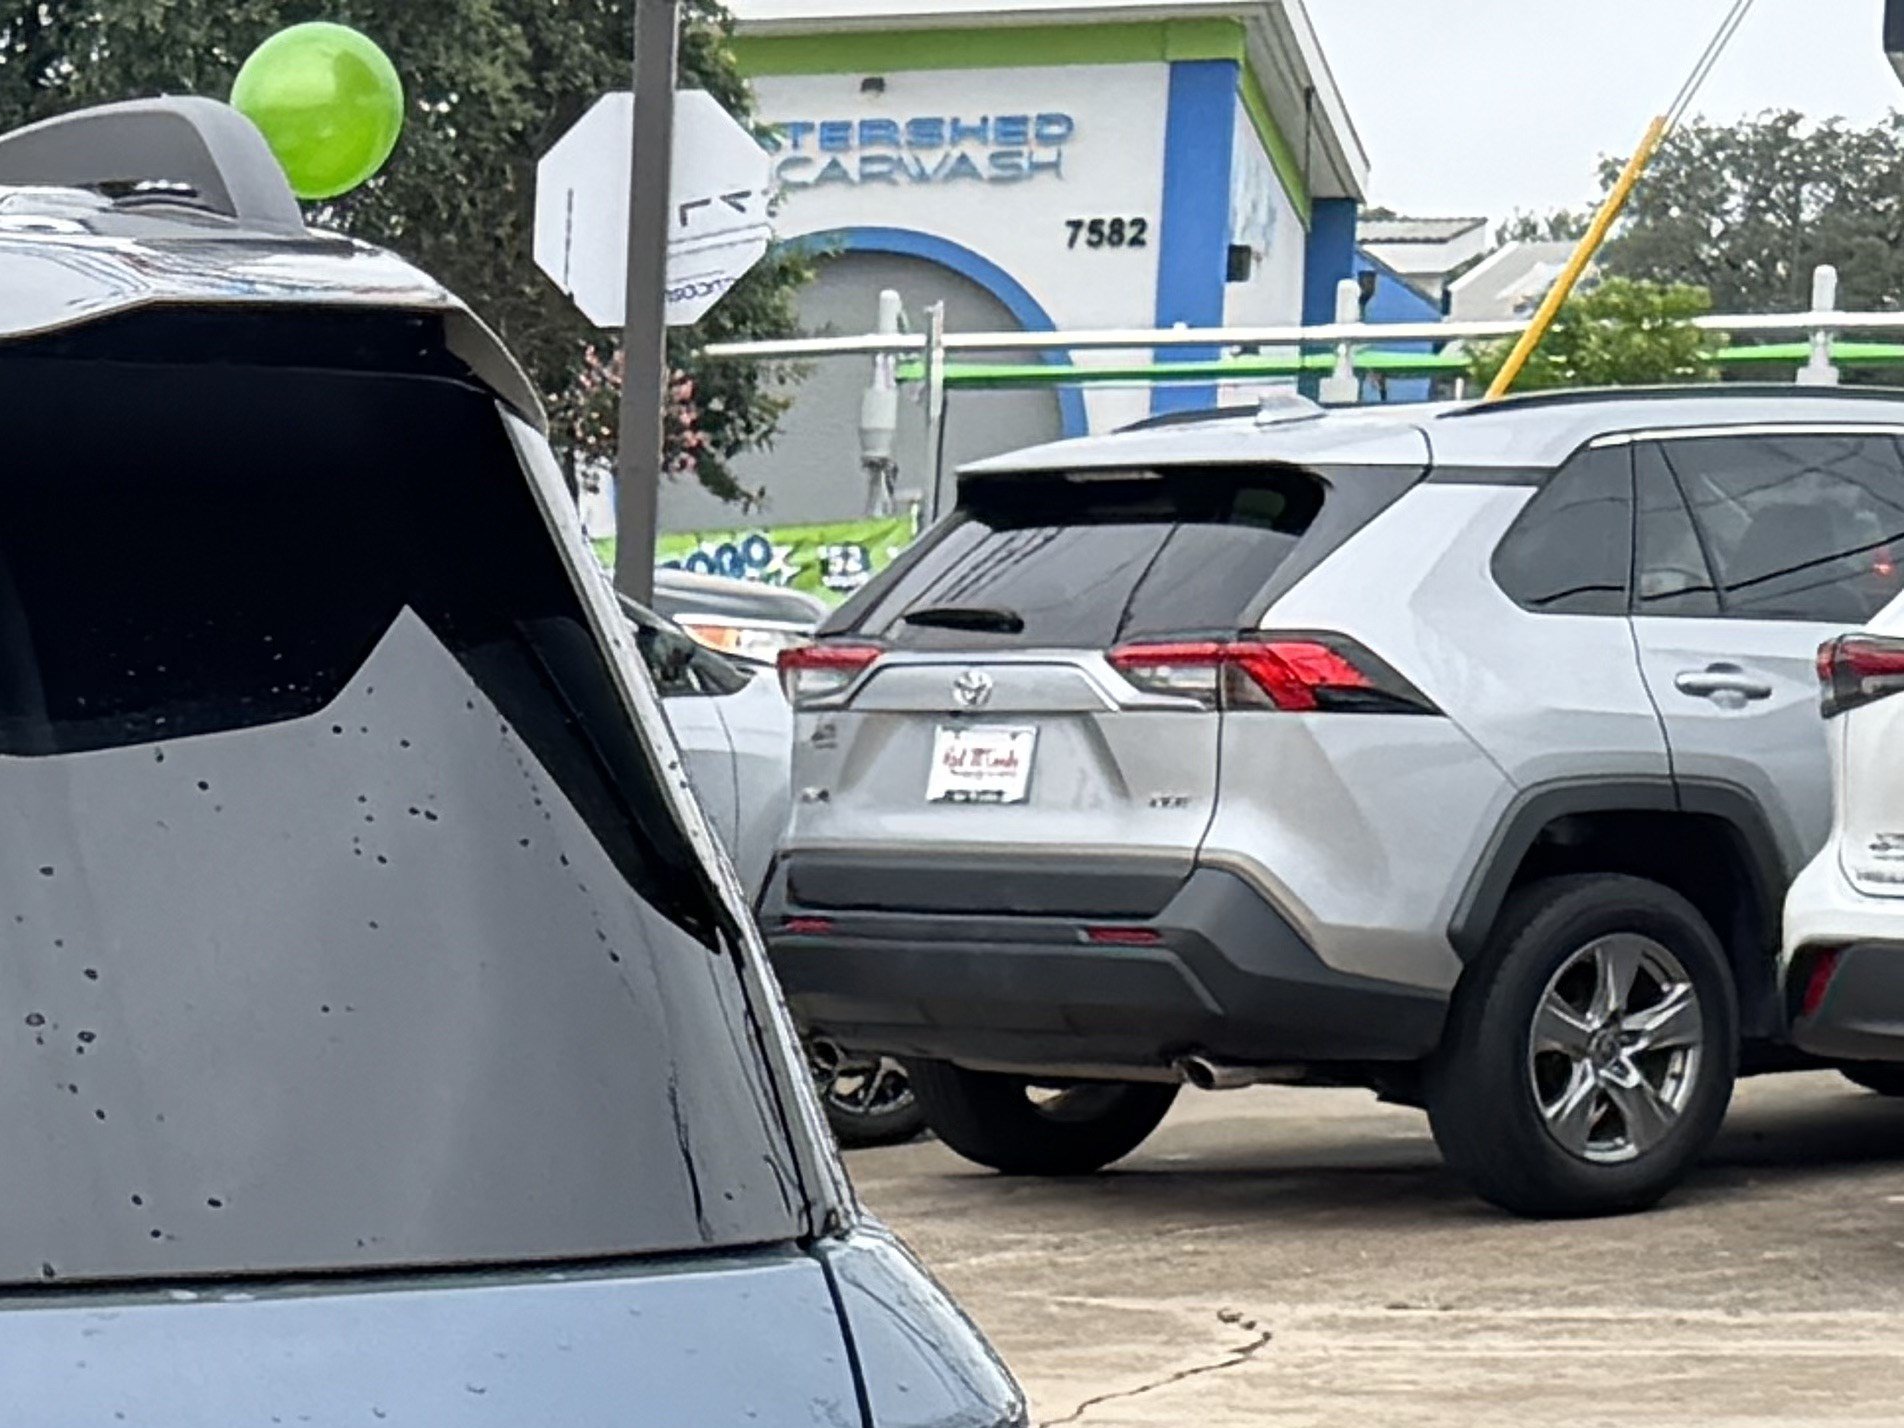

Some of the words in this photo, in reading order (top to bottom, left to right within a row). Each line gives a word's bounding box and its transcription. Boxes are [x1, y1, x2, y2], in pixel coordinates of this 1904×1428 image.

[770, 112, 1075, 152] TERSHED
[775, 148, 1065, 188] CARWASH
[1064, 216, 1148, 250] 7582
